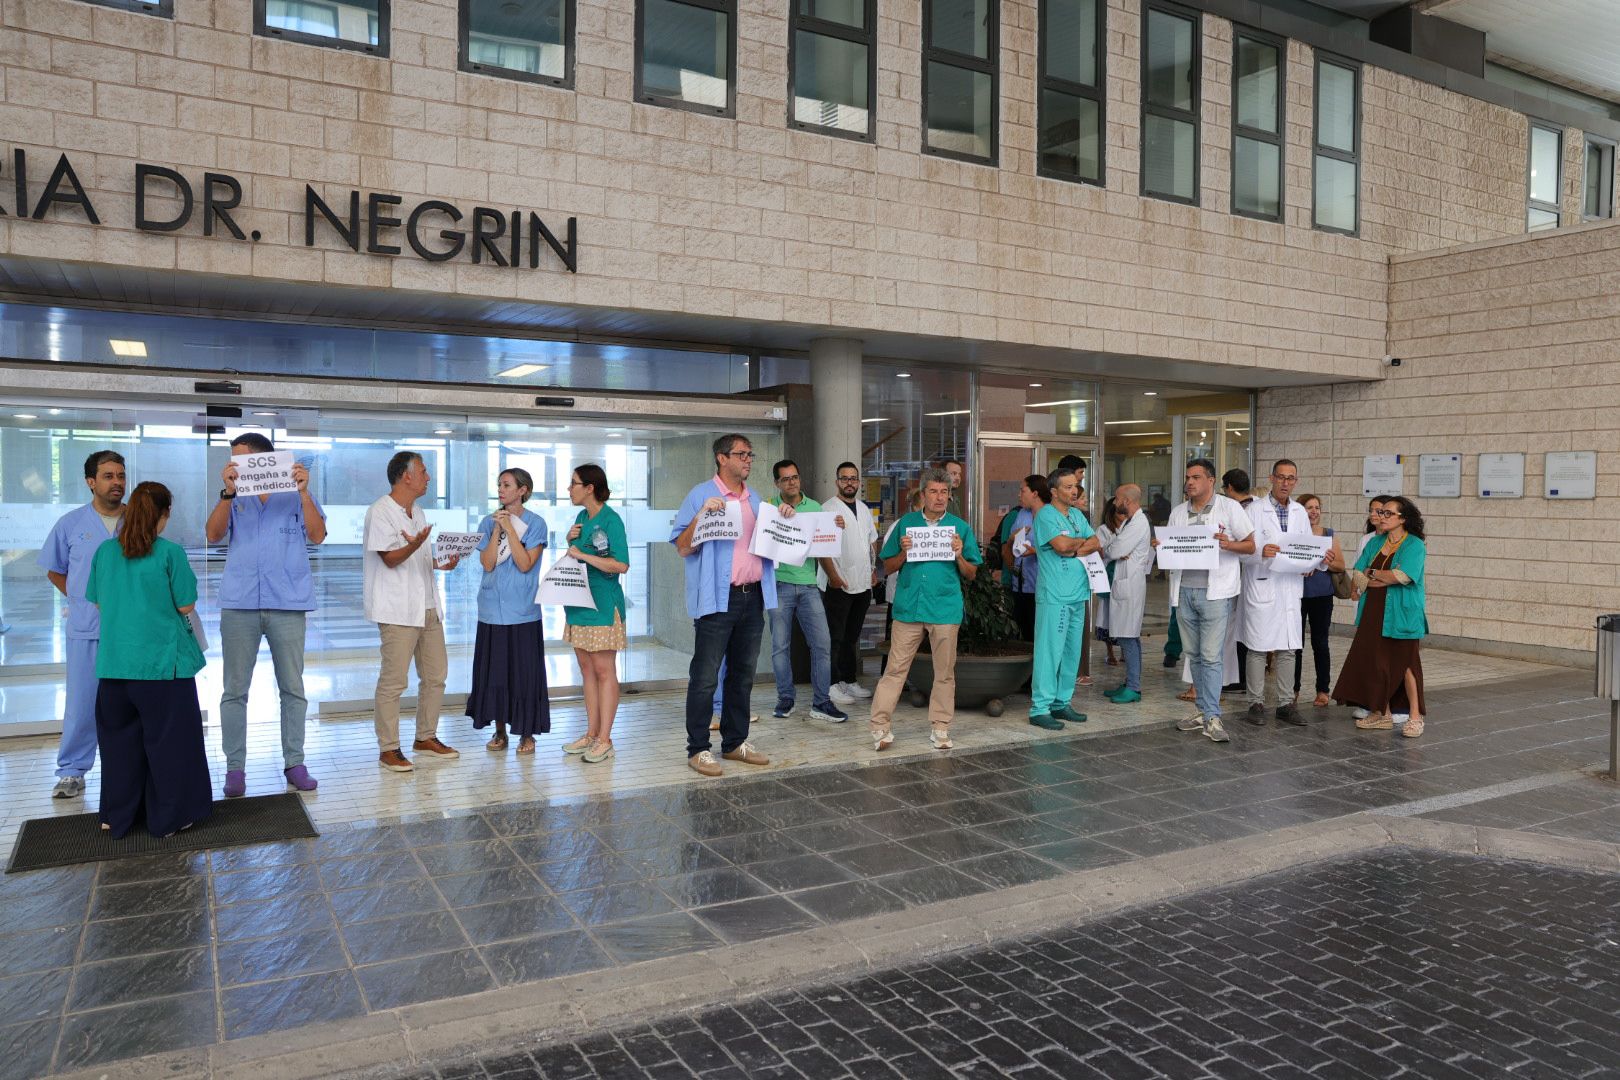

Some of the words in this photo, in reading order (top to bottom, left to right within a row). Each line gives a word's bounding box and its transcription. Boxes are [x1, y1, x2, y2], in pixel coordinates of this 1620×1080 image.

[0, 148, 100, 224] IA
[134, 162, 262, 241] DR.
[304, 183, 577, 274] NEGRIN
[248, 456, 277, 468] SCS
[240, 471, 279, 481] engaña
[253, 481, 297, 491] médicos
[436, 534, 460, 544] Stop
[461, 535, 482, 544] SCS
[702, 529, 739, 539] médicos
[907, 530, 930, 540] Stop
[932, 529, 954, 538] SCS
[445, 544, 462, 552] OPE
[931, 551, 954, 559] juego
